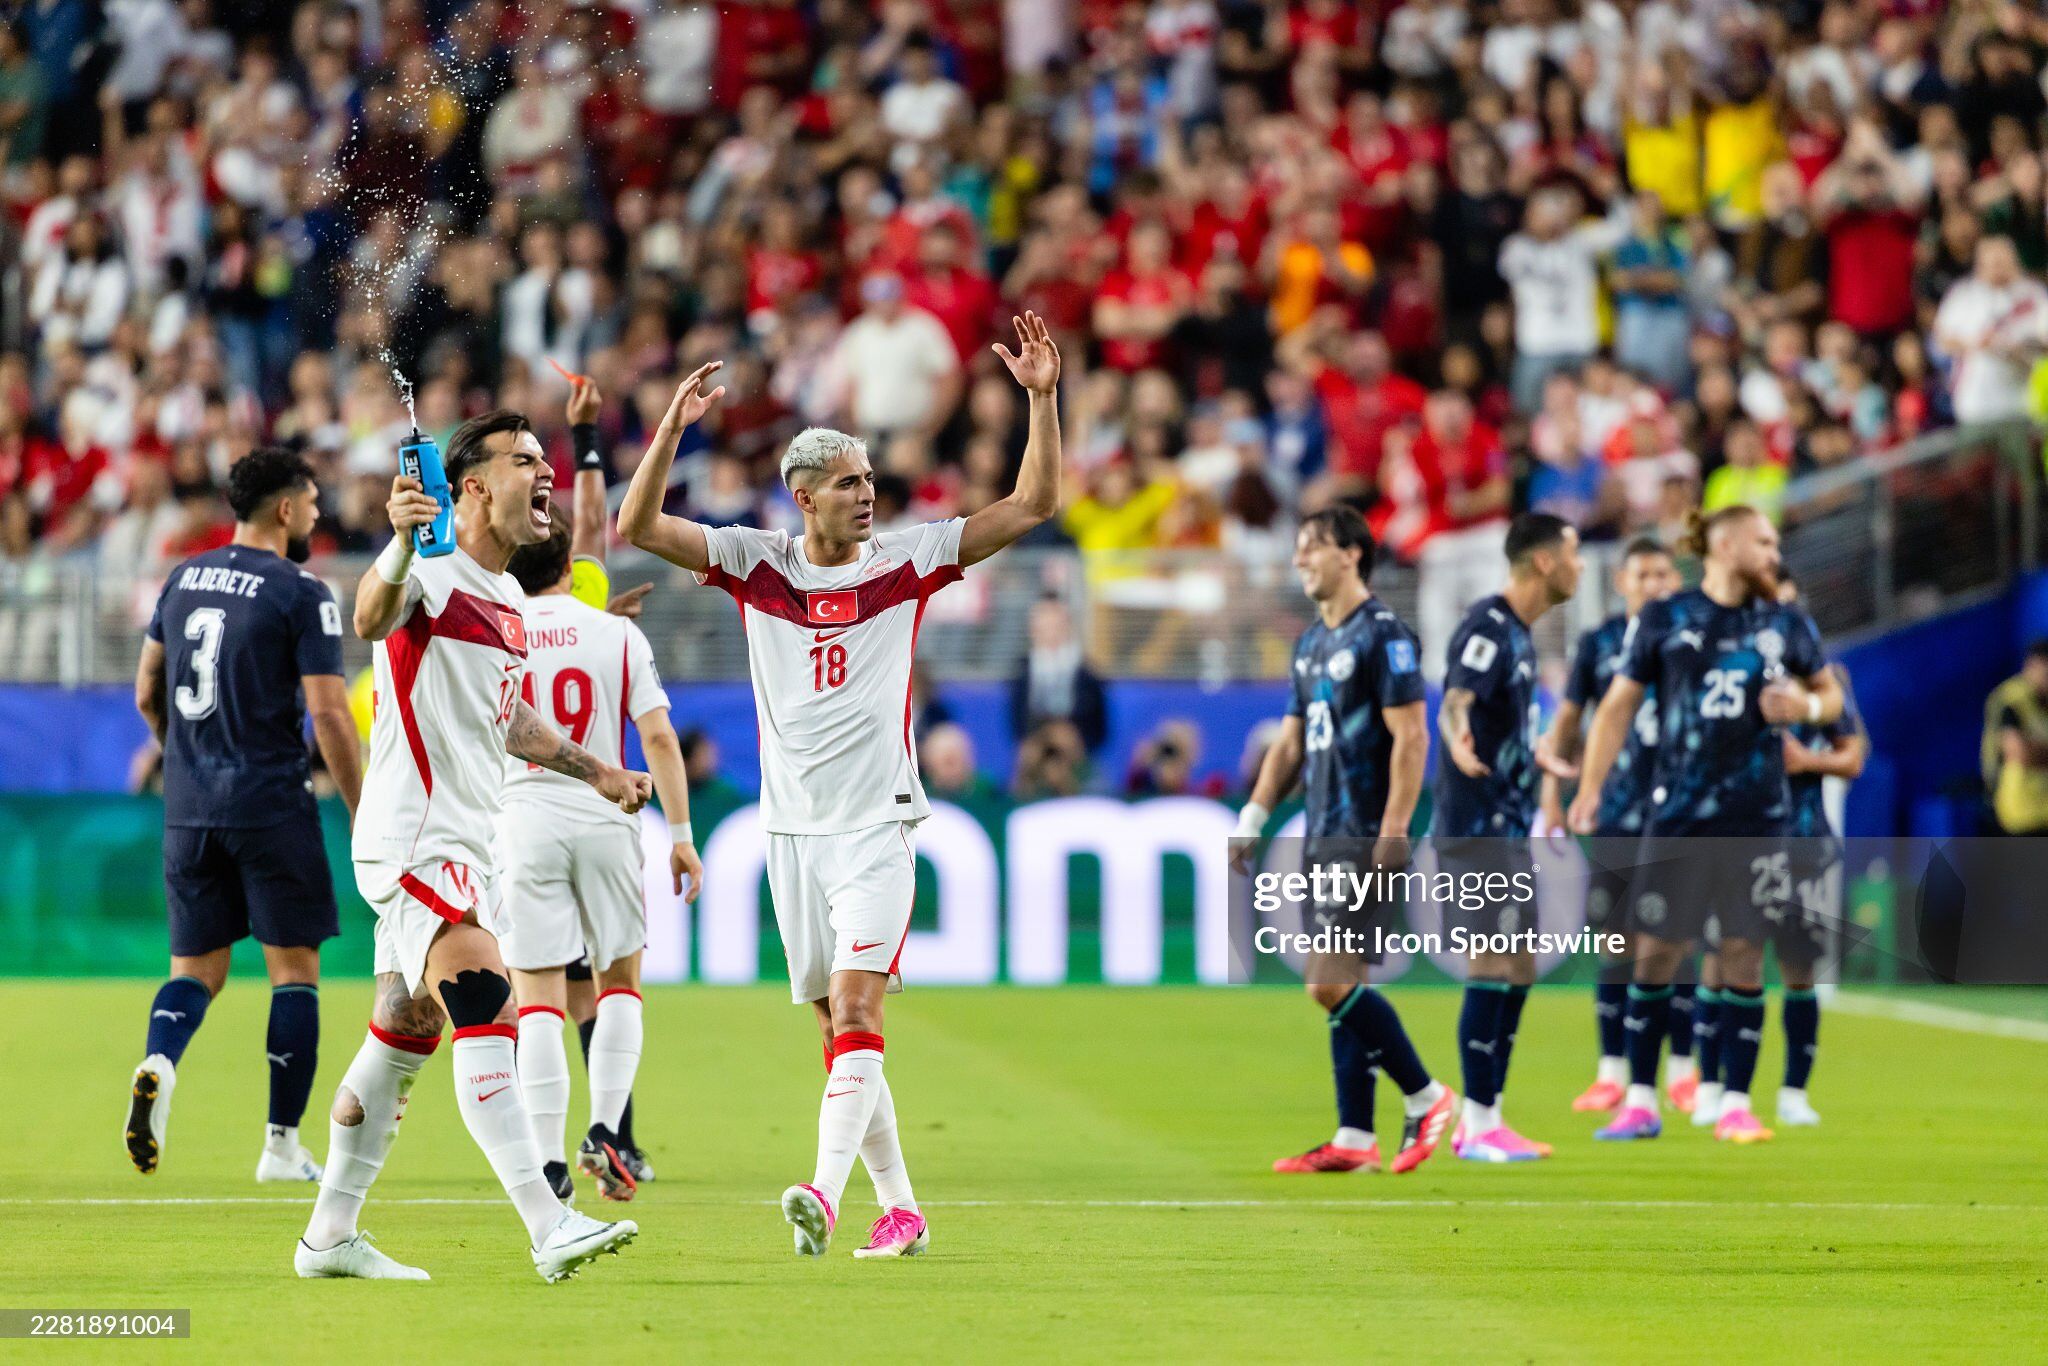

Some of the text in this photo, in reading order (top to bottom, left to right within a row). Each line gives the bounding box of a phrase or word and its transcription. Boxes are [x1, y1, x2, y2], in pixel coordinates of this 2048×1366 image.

[178, 566, 265, 598] ALDERETE
[526, 627, 577, 649] UNUS
[175, 607, 226, 720] 3
[809, 644, 848, 692] 18
[1700, 668, 1748, 719] 25
